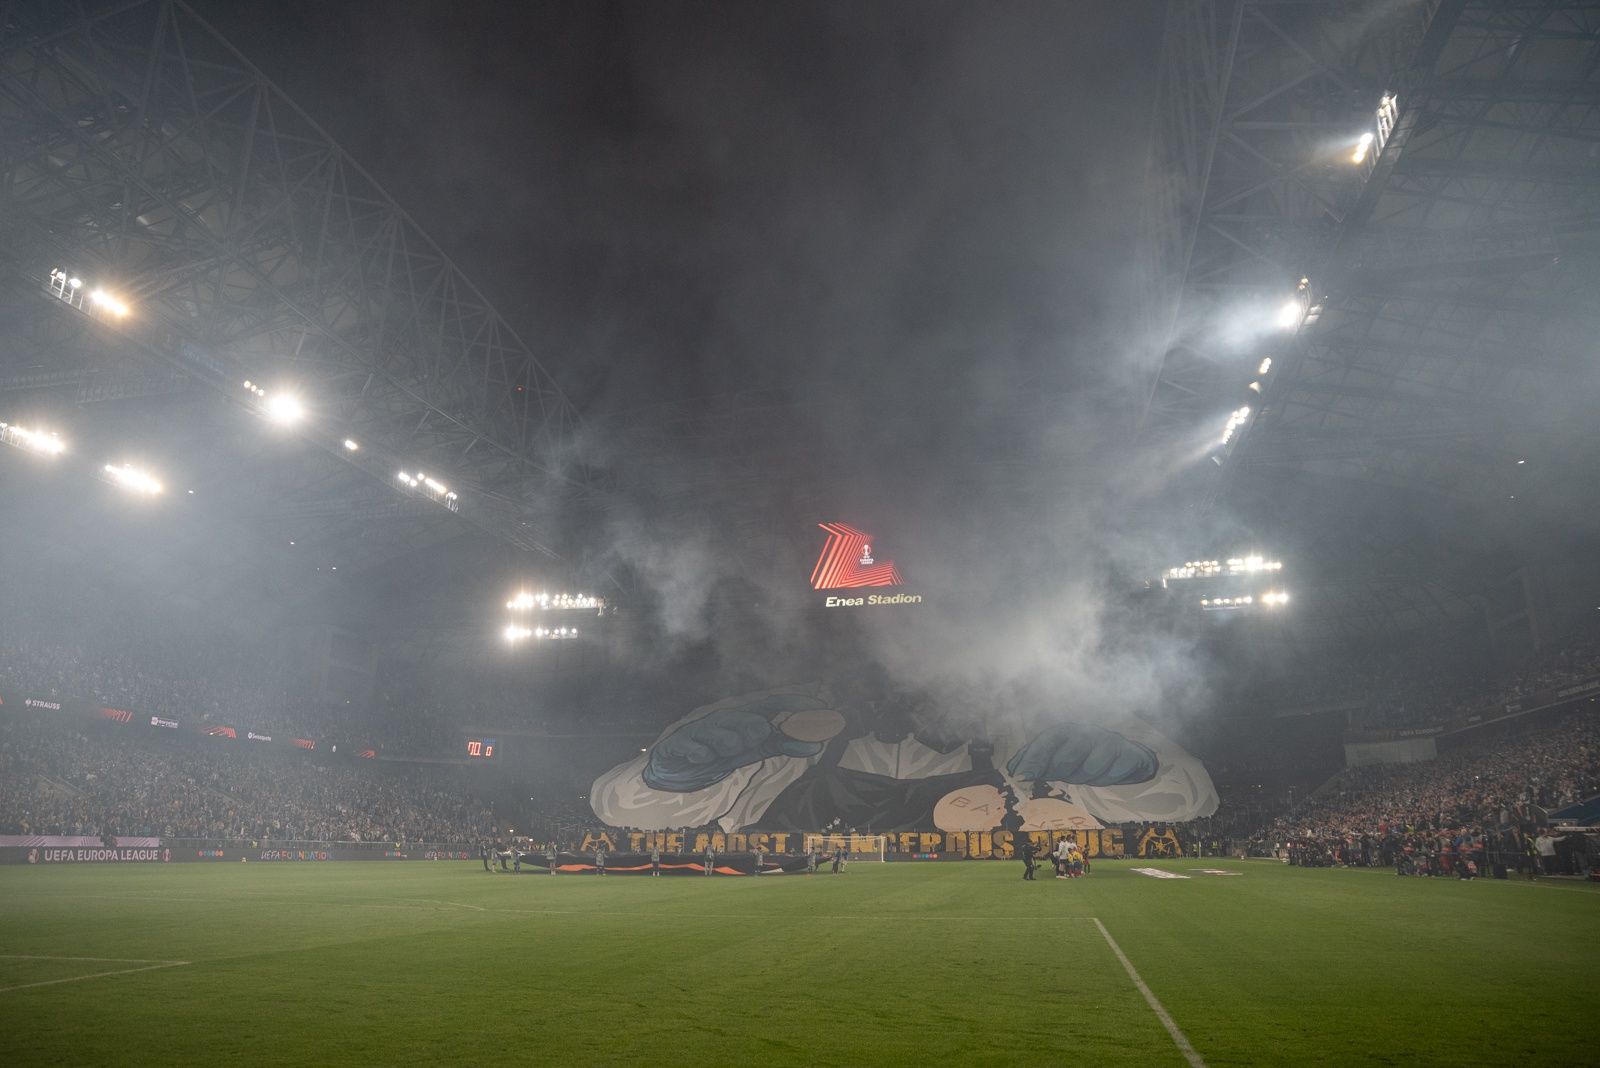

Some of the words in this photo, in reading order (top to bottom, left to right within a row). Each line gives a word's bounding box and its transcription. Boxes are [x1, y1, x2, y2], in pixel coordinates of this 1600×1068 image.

[826, 596, 864, 608] Enea
[867, 594, 922, 605] Stadion
[32, 700, 61, 710] STRAUSS
[44, 849, 75, 861] UEFA
[77, 849, 118, 861] EUROPA
[121, 849, 158, 860] LEAGUE
[261, 850, 280, 860] UEFA
